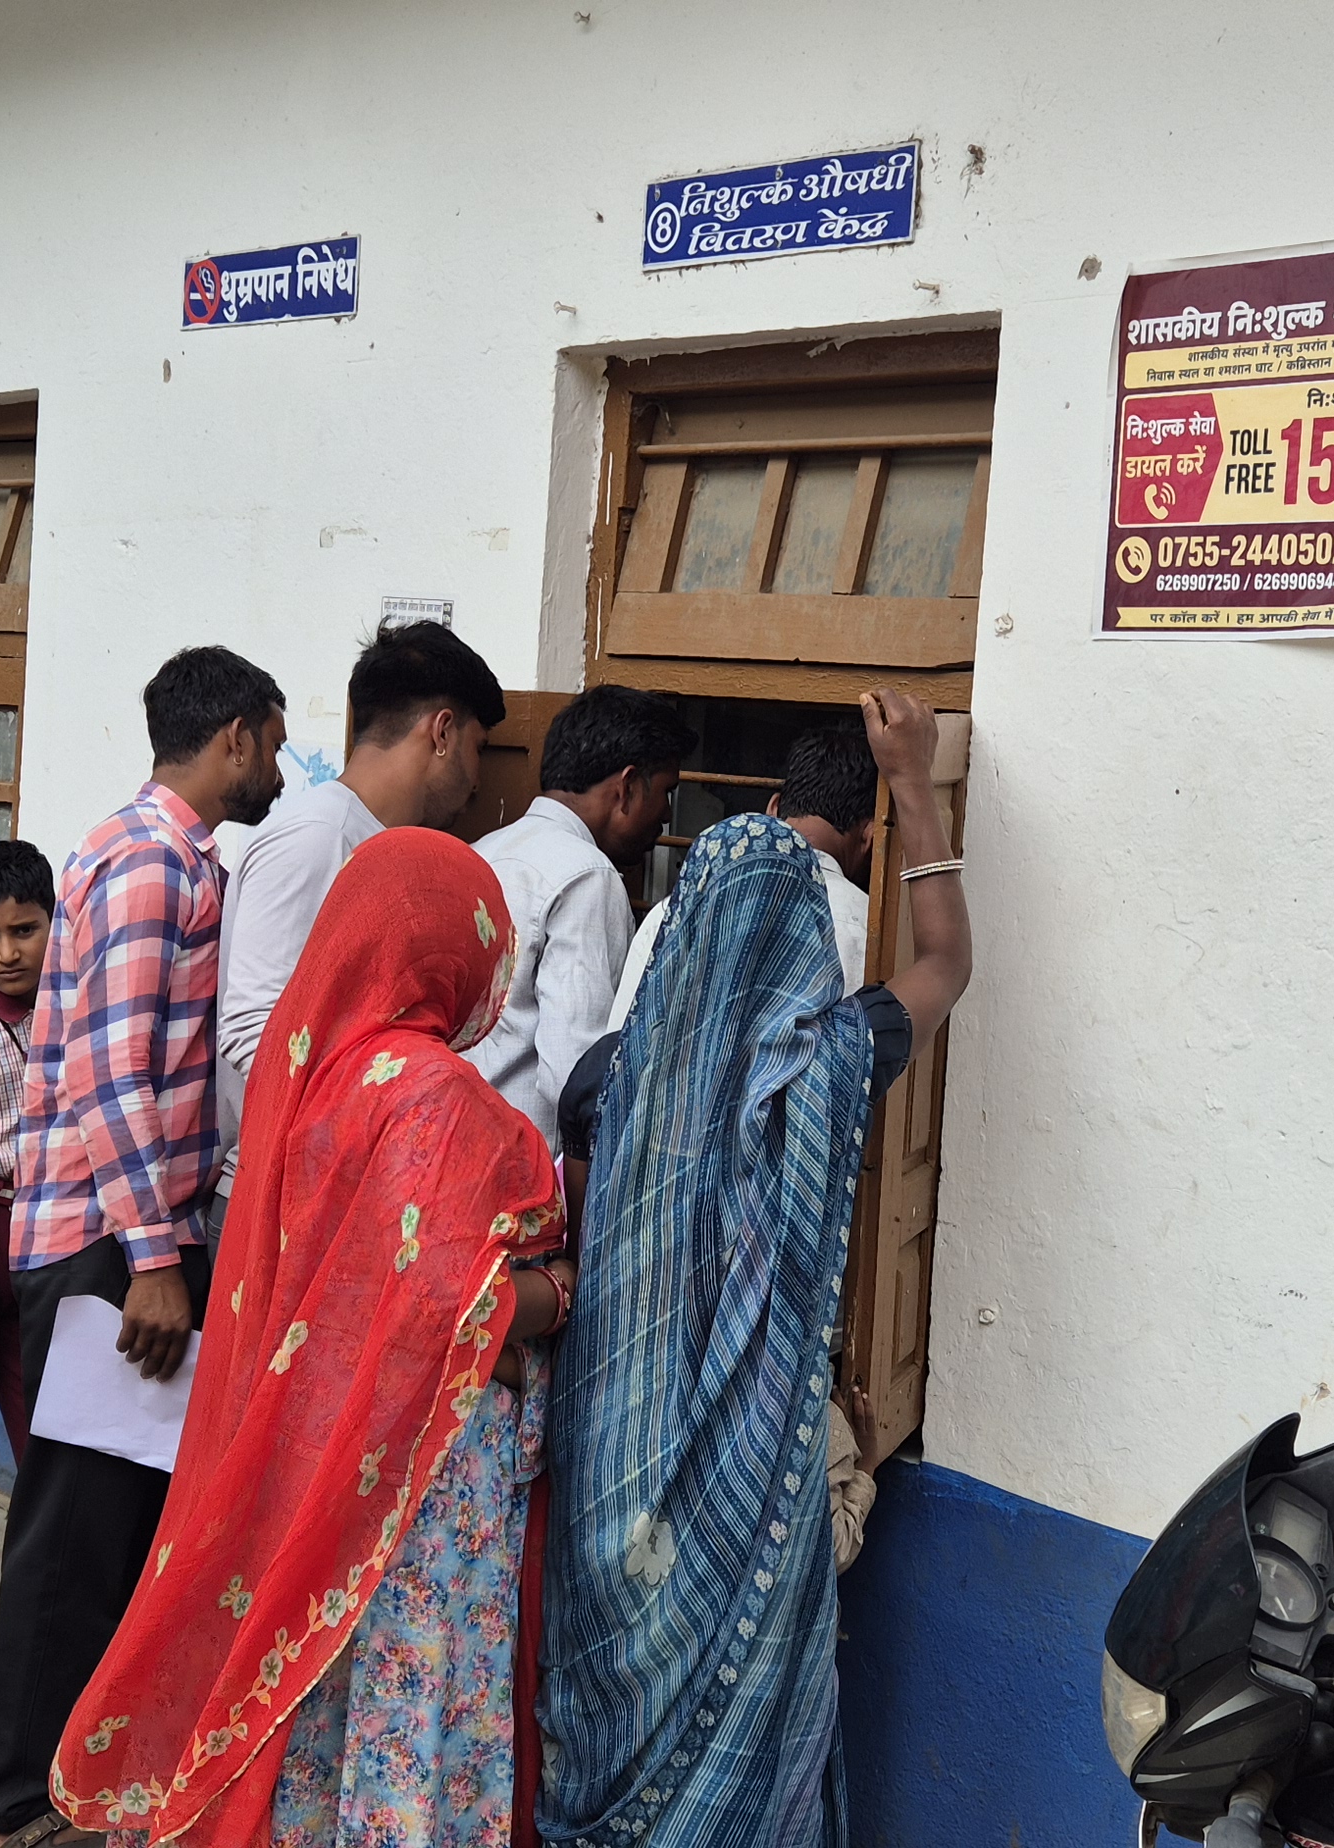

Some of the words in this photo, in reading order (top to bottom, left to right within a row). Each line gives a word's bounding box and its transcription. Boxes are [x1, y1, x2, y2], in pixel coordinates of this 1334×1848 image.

[655, 207, 672, 244] 8
[679, 177, 798, 222] निशुल्क
[799, 152, 913, 202] औषधी
[687, 219, 812, 256] वितरण
[296, 244, 356, 299] निषेध
[1127, 306, 1222, 346] शासकीय
[1188, 347, 1229, 363] शासकीय
[1232, 345, 1258, 358] संस्था
[1262, 342, 1270, 355] में
[1273, 343, 1293, 358] मृत्यु
[1297, 338, 1327, 353] उपरांत
[1147, 368, 1175, 383] निवास
[1179, 367, 1200, 380] स्थल
[1203, 366, 1215, 378] या
[1255, 361, 1274, 374] घाट
[1188, 411, 1216, 437] सेवा
[1230, 428, 1273, 457] TOLL
[1125, 454, 1173, 479] डायल
[1176, 445, 1207, 476] करें
[1225, 462, 1276, 495] FREE
[1156, 573, 1240, 591] 6269907250
[1243, 573, 1251, 591] /
[1150, 613, 1165, 623] पर
[1169, 610, 1197, 623] कॉल
[1201, 610, 1221, 623] करें
[1237, 613, 1254, 625] हम
[1259, 609, 1298, 624] आपकी
[1301, 609, 1321, 622] सेवा
[1325, 607, 1334, 621] में
